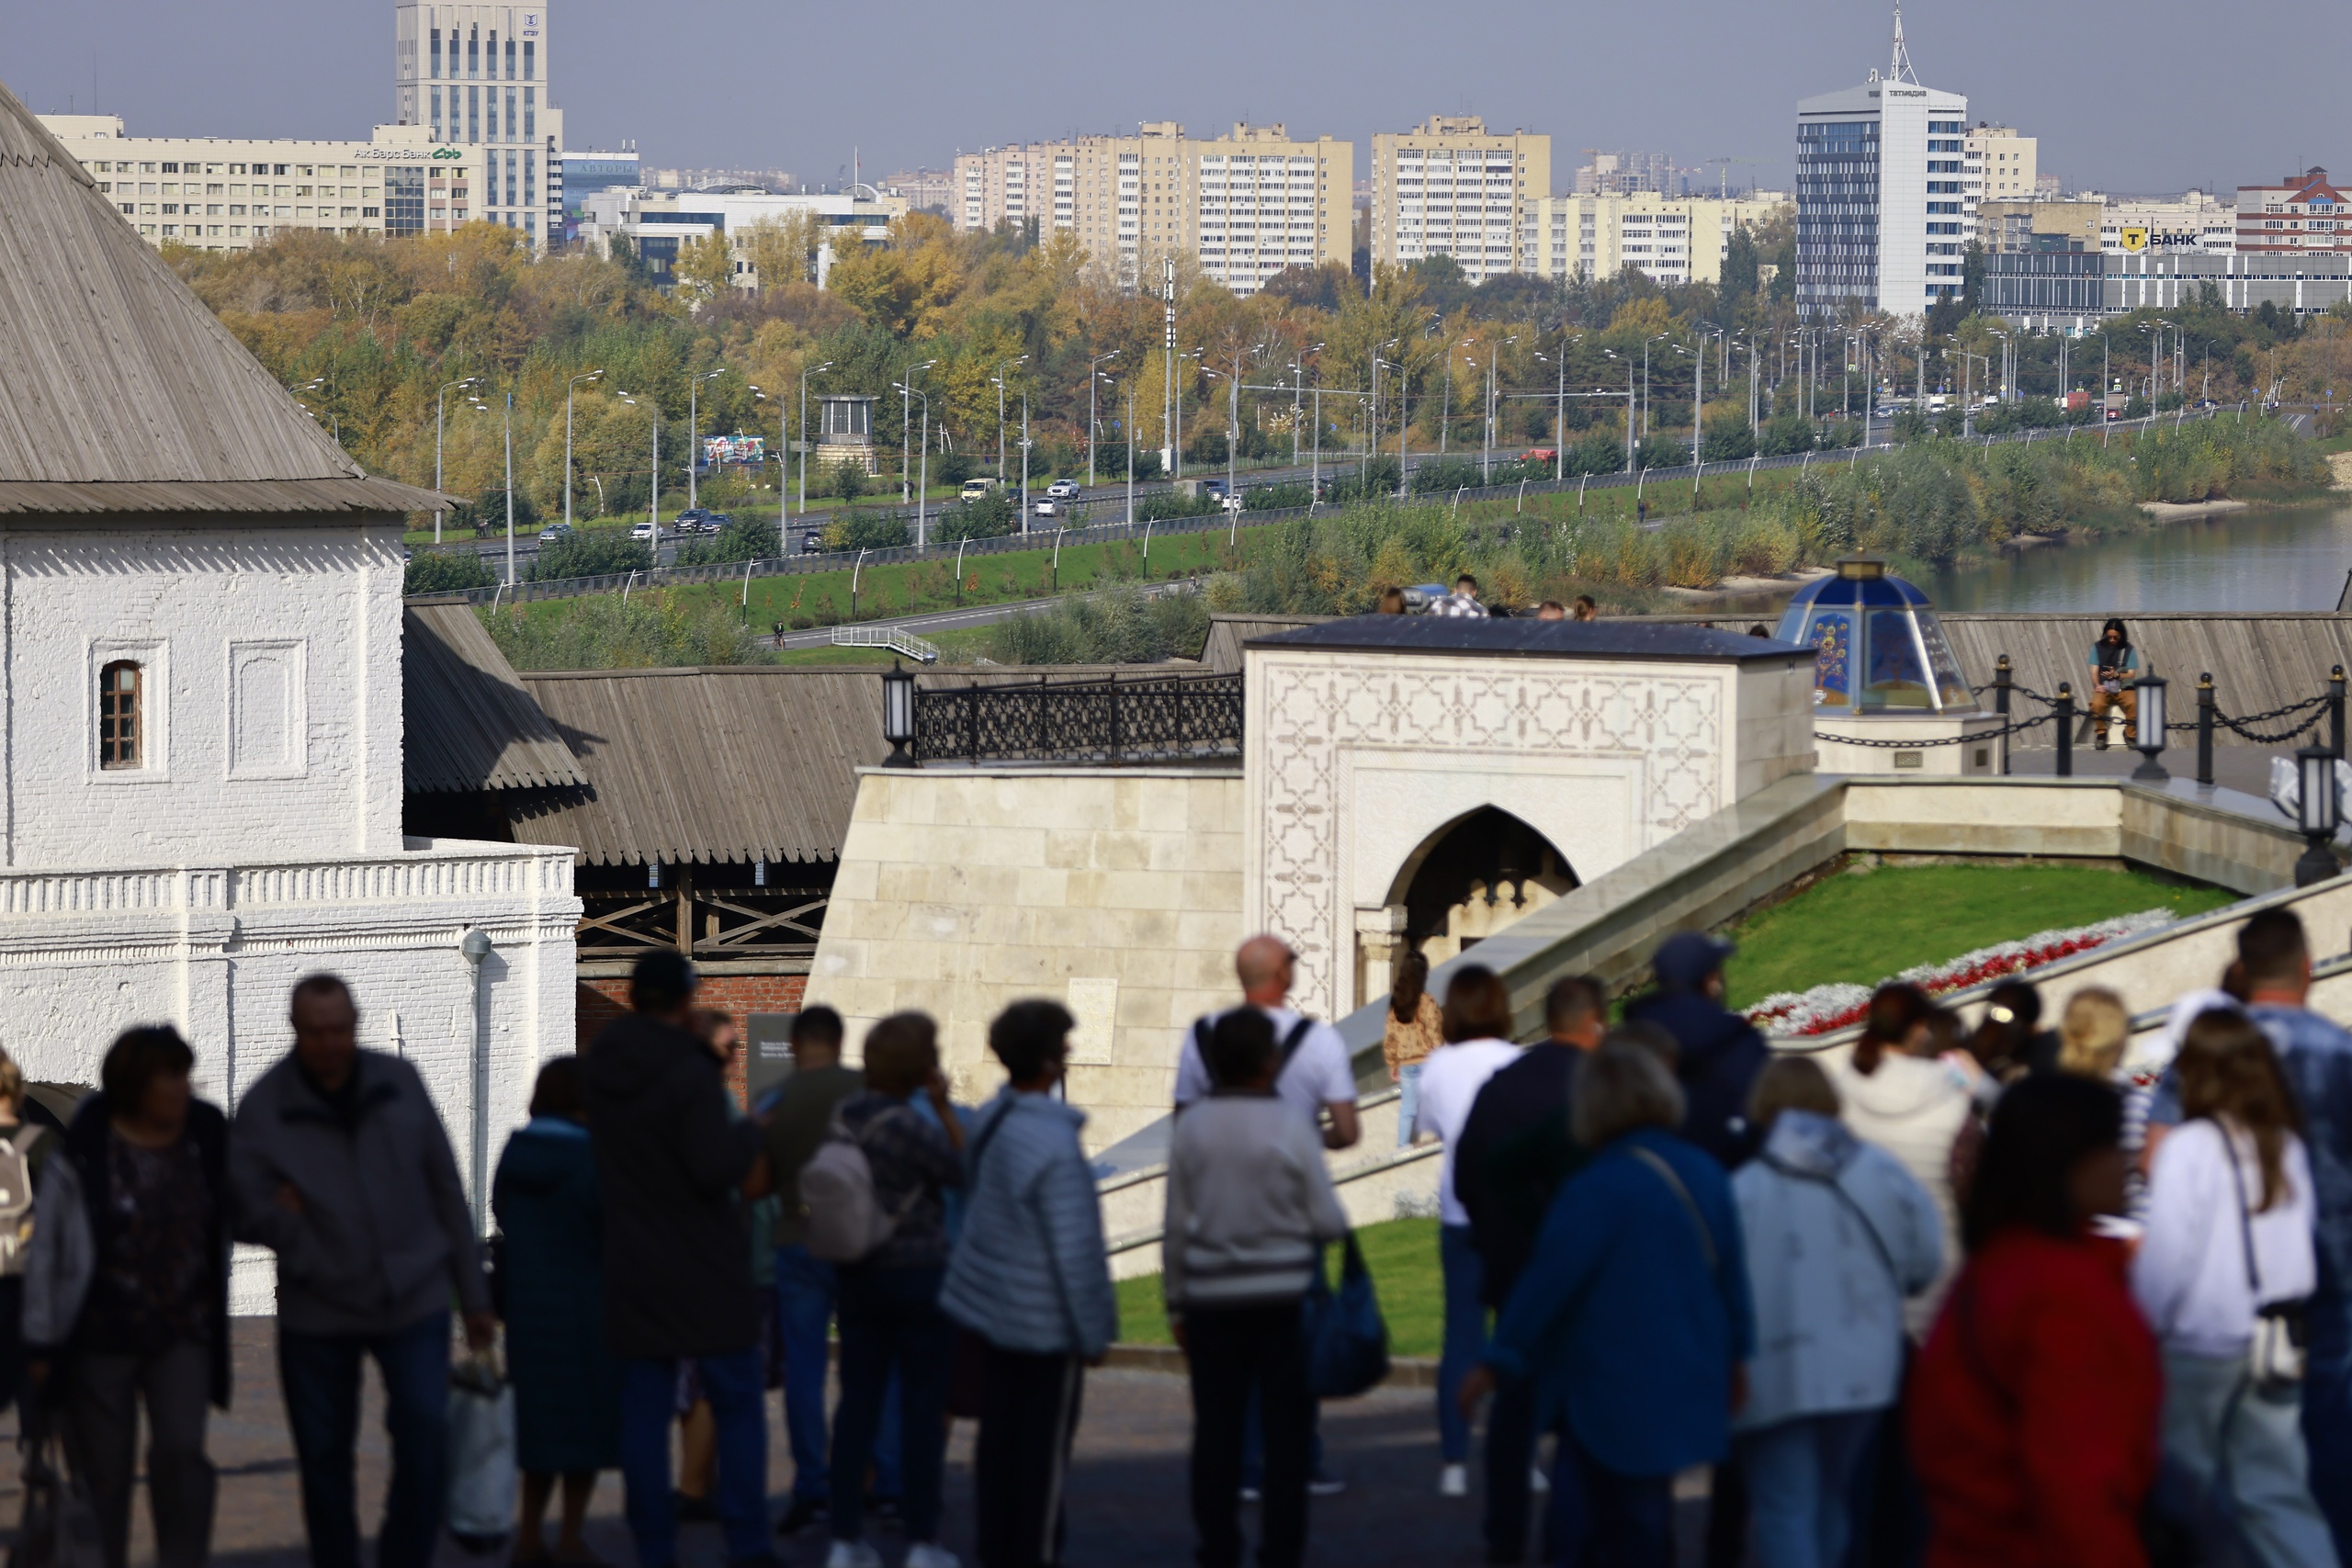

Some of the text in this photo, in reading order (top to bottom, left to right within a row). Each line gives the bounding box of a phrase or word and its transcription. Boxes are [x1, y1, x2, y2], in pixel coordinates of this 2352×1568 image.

[355, 148, 431, 161] Ак Барс Банк
[580, 164, 632, 173] АВТОРЫ
[2150, 234, 2197, 246] БАНК
